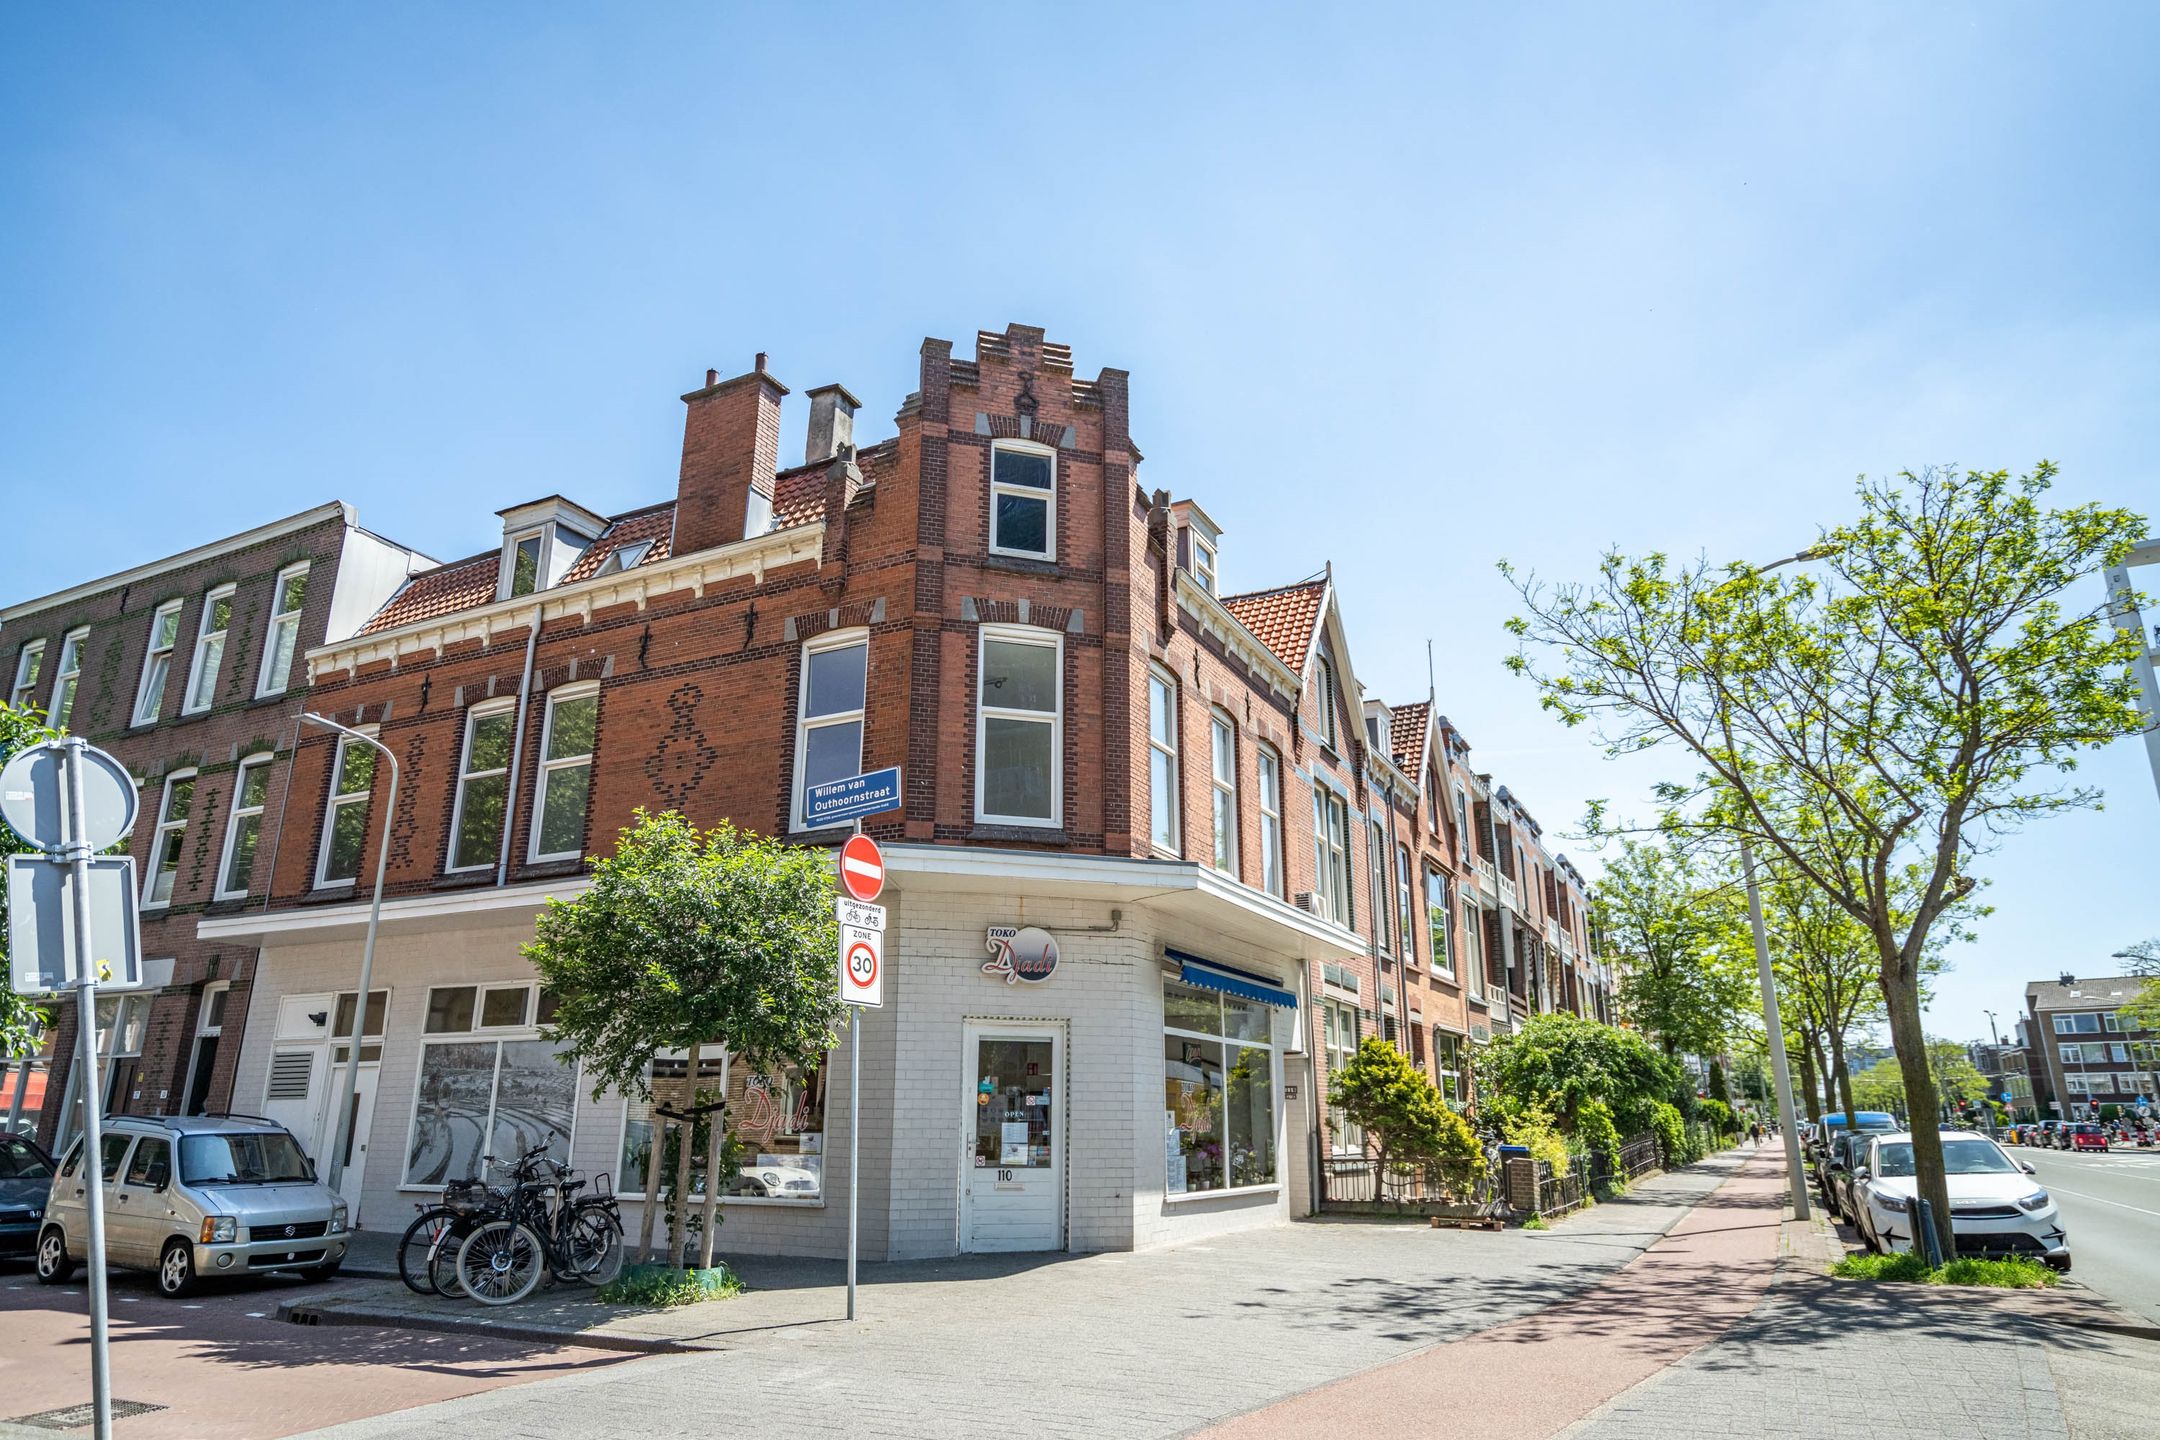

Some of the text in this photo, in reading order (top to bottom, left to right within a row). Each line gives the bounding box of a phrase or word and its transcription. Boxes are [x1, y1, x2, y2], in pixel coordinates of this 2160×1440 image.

[815, 780, 865, 798] Willem van
[815, 786, 890, 811] Outhoornstraat
[844, 900, 881, 914] uitgezonderd
[853, 930, 872, 940] ZONE
[990, 929, 1016, 938] TOKO
[852, 955, 872, 974] 30
[982, 938, 1053, 983] Djadi
[738, 1087, 809, 1143] Djadi
[998, 1169, 1013, 1182] 110
